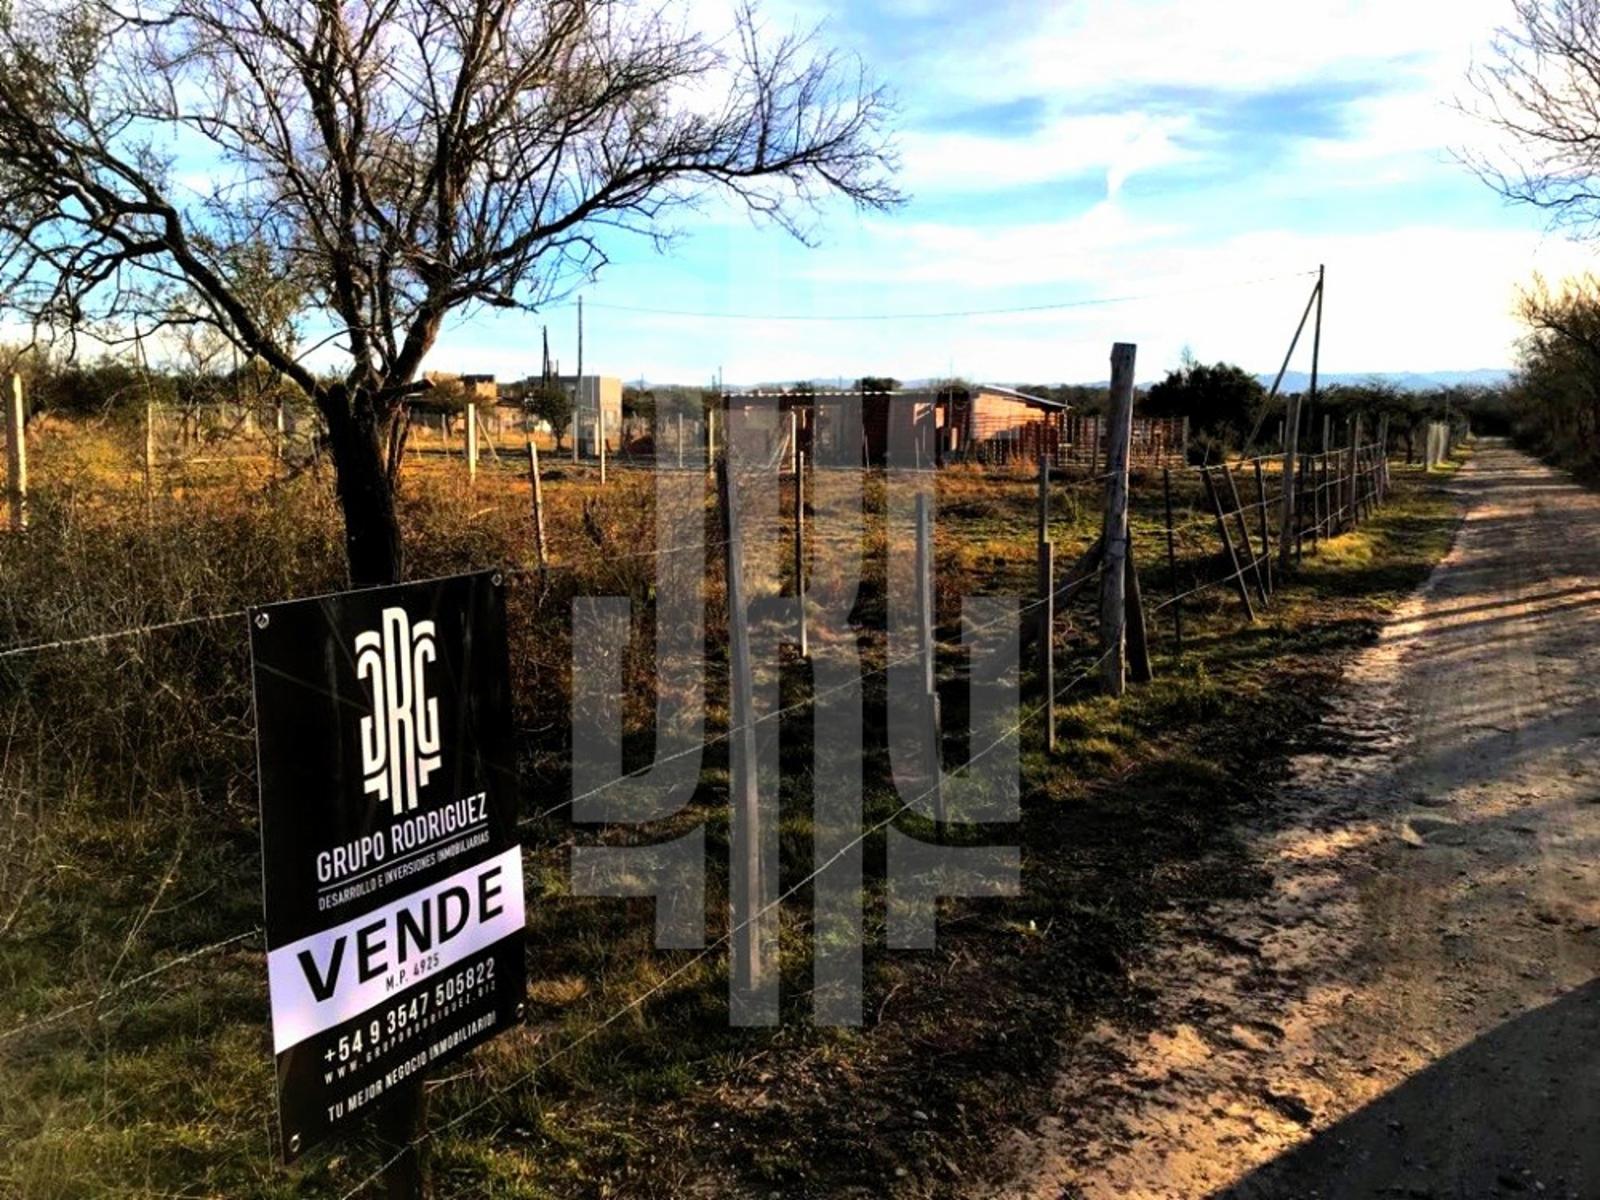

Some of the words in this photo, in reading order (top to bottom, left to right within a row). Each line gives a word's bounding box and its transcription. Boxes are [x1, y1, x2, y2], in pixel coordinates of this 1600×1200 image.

[316, 831, 385, 883] GRUPO
[391, 791, 489, 854] RODRIGUEZ
[318, 878, 377, 911] DESARROLLO
[378, 876, 384, 889] E
[384, 853, 437, 886] INVERSIONES
[297, 865, 505, 1003] VENDE
[385, 971, 409, 991] M.P.
[413, 952, 440, 976] 4925
[324, 1029, 363, 1062] +54
[369, 1019, 381, 1045] 9
[386, 992, 429, 1035] 3547
[435, 956, 496, 1007] 505822
[327, 1102, 345, 1123] TU
[347, 1079, 384, 1113] MEJOR
[384, 1050, 428, 1089] NEGOCIO
